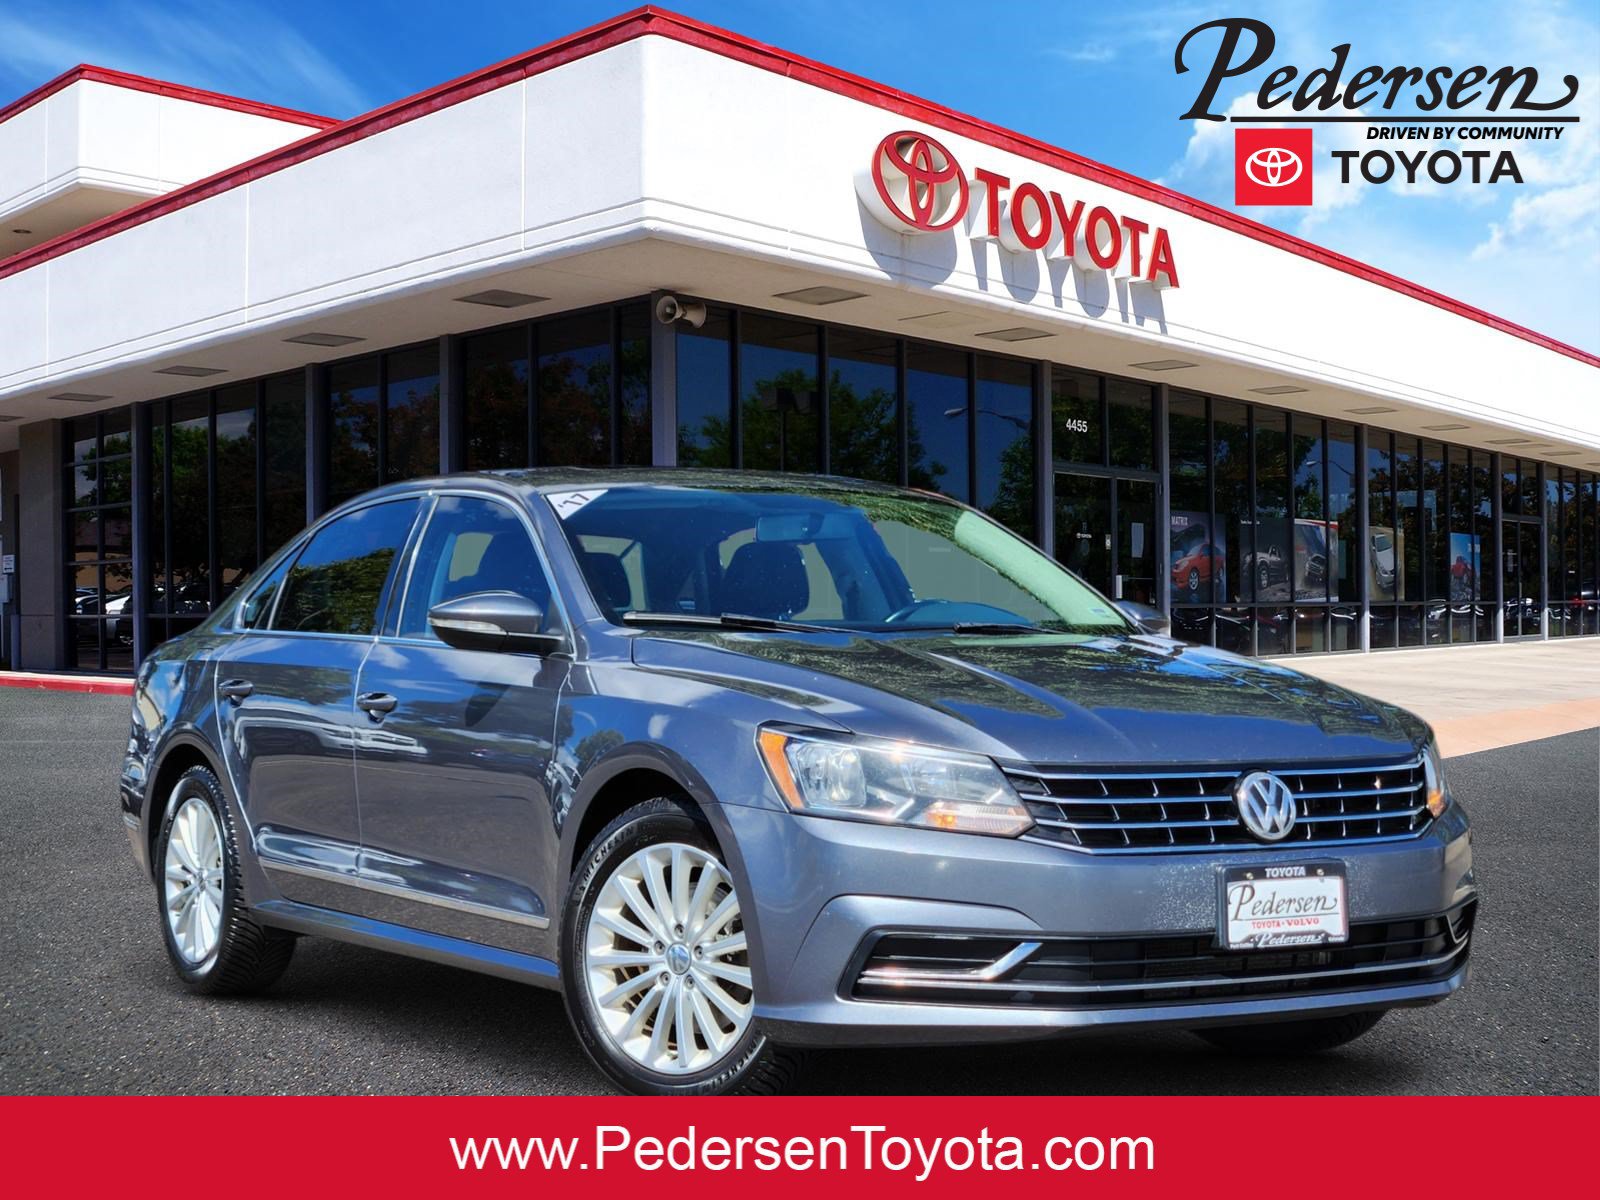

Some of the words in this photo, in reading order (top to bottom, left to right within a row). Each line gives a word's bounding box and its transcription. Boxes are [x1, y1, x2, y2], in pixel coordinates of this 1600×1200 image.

[974, 167, 1180, 289] TOYOTA
[1065, 418, 1088, 433] 4455
[1171, 516, 1188, 526] MATRIX
[583, 825, 635, 882] MICHELIN
[1265, 866, 1307, 878] TOYOTA
[1228, 884, 1338, 922] Pedersen
[1252, 920, 1281, 929] TOYOTA
[1286, 918, 1319, 927] VOLVO
[1255, 932, 1325, 949] Pedersen
